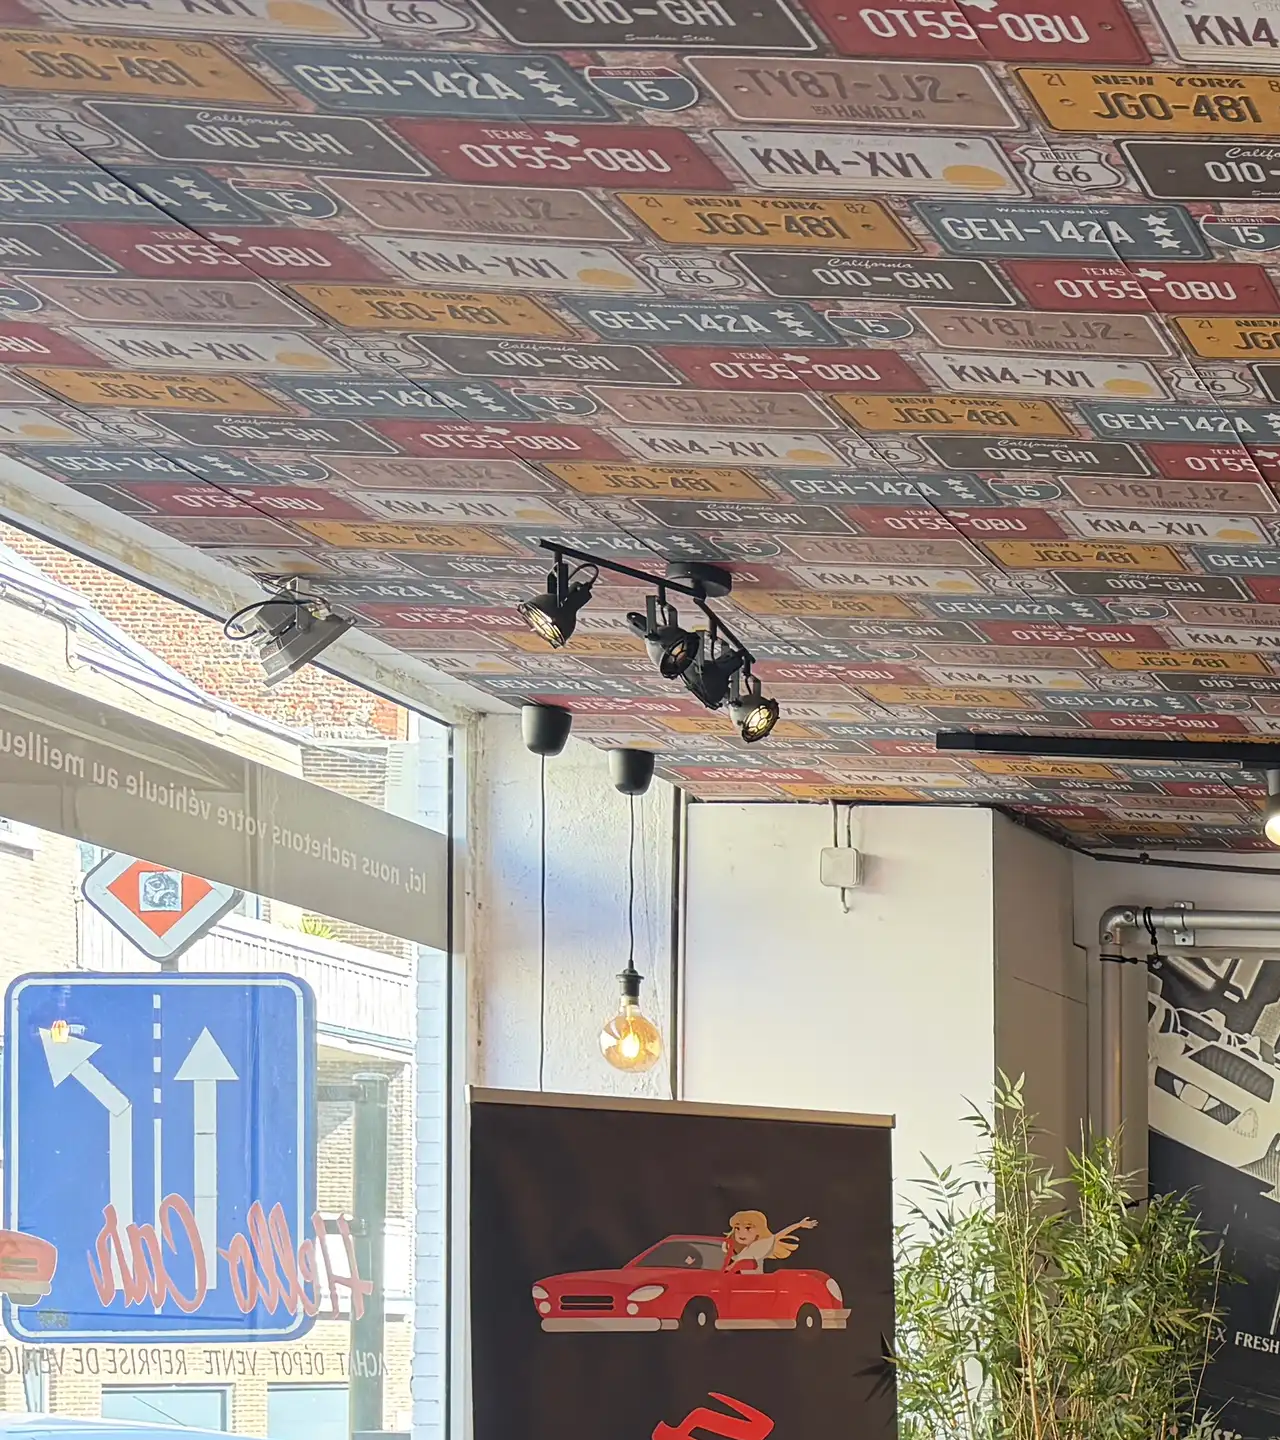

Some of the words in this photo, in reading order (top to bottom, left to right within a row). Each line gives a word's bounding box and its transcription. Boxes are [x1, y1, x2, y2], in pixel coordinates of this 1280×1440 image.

[297, 66, 522, 101] GEH-142A
[625, 79, 671, 103] 15
[1092, 74, 1157, 87] NEW
[1168, 77, 1246, 90] YORK
[482, 129, 533, 139] TEXAS
[1050, 165, 1093, 183] 66
[942, 216, 1134, 244] GEH-142A
[1231, 225, 1266, 244] 15
[589, 310, 769, 333] GEH-142A
[296, 388, 465, 408] GEH-142A
[1235, 1331, 1279, 1355] FRESH
